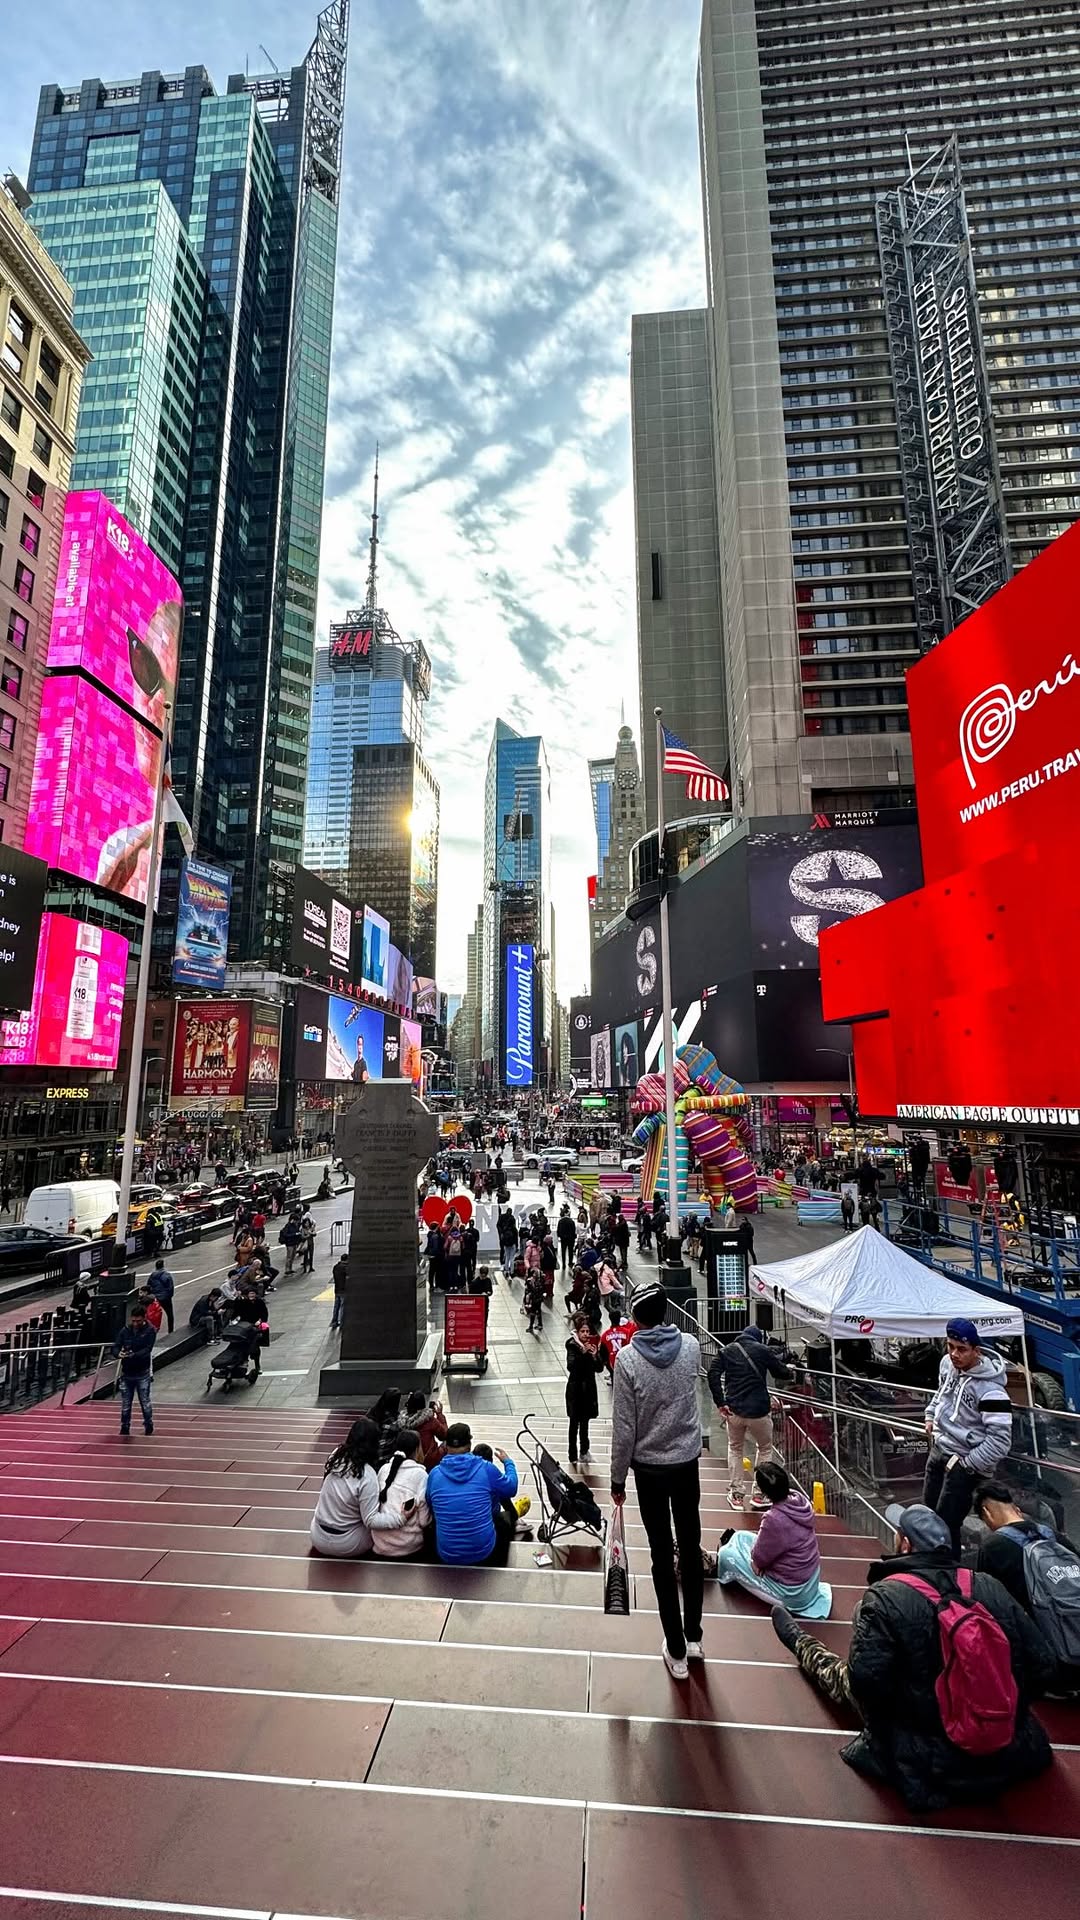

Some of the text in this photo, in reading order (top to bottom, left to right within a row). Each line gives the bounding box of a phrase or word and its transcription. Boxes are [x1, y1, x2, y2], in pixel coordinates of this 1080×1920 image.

[943, 286, 984, 459] OUTFITTERS
[914, 271, 960, 510] AMERICAN EAGLE
[107, 516, 130, 552] K18
[65, 541, 81, 608] available at
[331, 630, 373, 657] H&M
[834, 811, 879, 819] MARRIOTT
[8, 874, 17, 886] is
[328, 974, 362, 998] 1540
[506, 945, 533, 1080] Paramount+
[6, 1021, 29, 1035] K18
[303, 1024, 323, 1034] GoPro
[183, 1068, 237, 1079] HARMONY
[46, 1087, 89, 1099] EXPRESS
[898, 1105, 960, 1120] AMERICAN
[963, 1107, 1008, 1122] EAGLE
[843, 1315, 866, 1324] PRG
